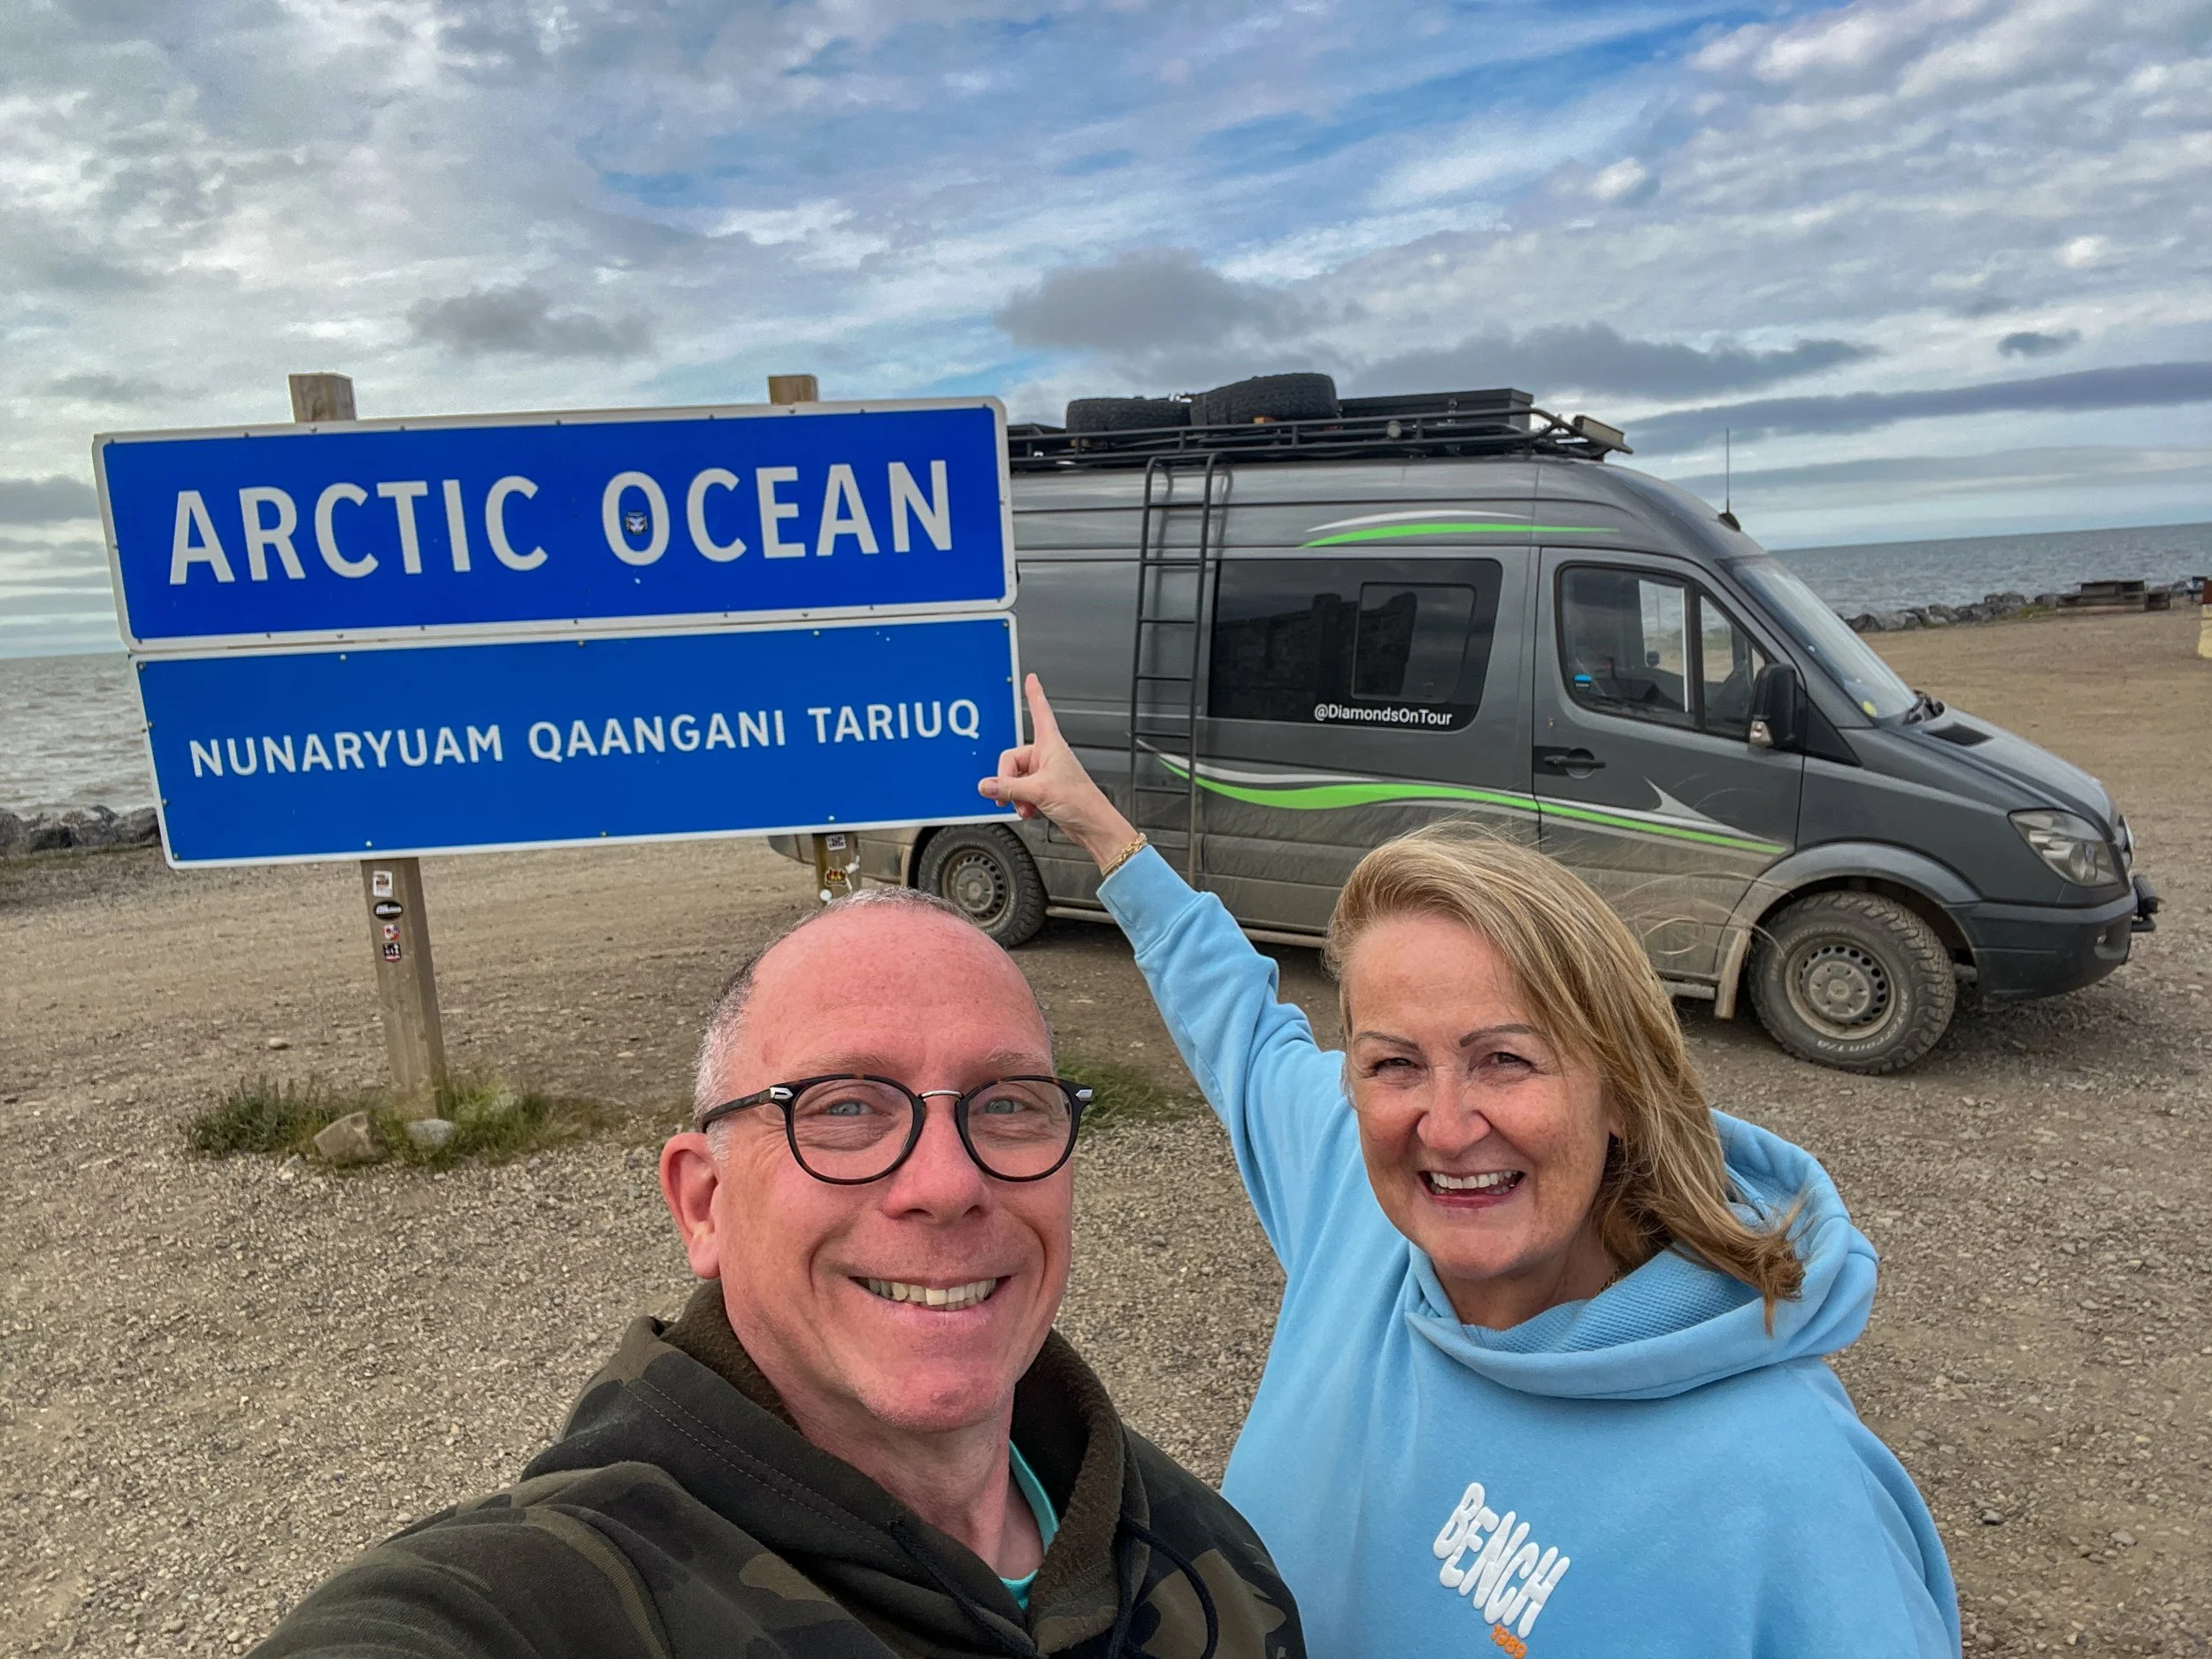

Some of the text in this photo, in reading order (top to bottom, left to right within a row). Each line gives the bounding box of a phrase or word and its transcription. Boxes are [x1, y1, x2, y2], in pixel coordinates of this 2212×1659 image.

[169, 459, 953, 585] ARCTIC OCEAN
[188, 698, 980, 779] NUNARYUAM QAANGANI TARIUQ
[1314, 703, 1453, 726] @DiamondsOnTour
[1433, 1482, 1571, 1639] BENCH
